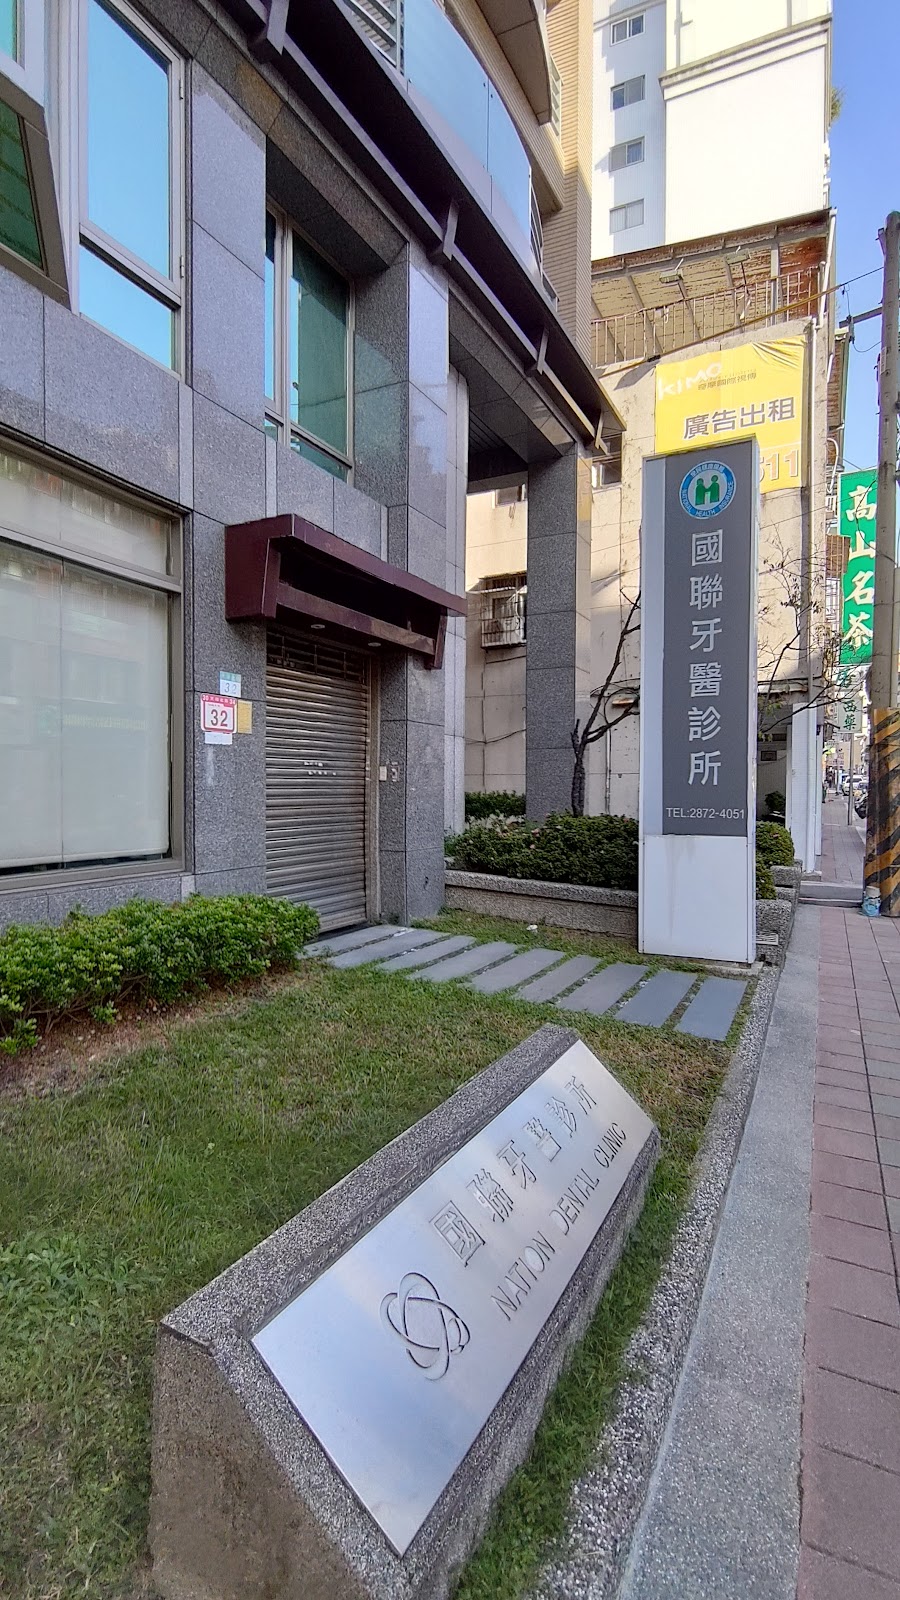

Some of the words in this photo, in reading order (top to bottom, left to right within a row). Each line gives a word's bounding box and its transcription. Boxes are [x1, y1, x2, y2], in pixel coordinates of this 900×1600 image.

[683, 396, 796, 440] 廣告出租
[842, 485, 878, 646] 高山名茶
[224, 682, 237, 694] 32
[688, 530, 723, 787] 國聯牙醫診所
[210, 709, 228, 727] 32
[665, 807, 745, 819] TEL:2872-4051
[429, 1075, 597, 1268] 國聯牙醫診所
[491, 1230, 556, 1321] NATION
[549, 1168, 600, 1236] DENTAL
[593, 1122, 627, 1169] CLINIC
